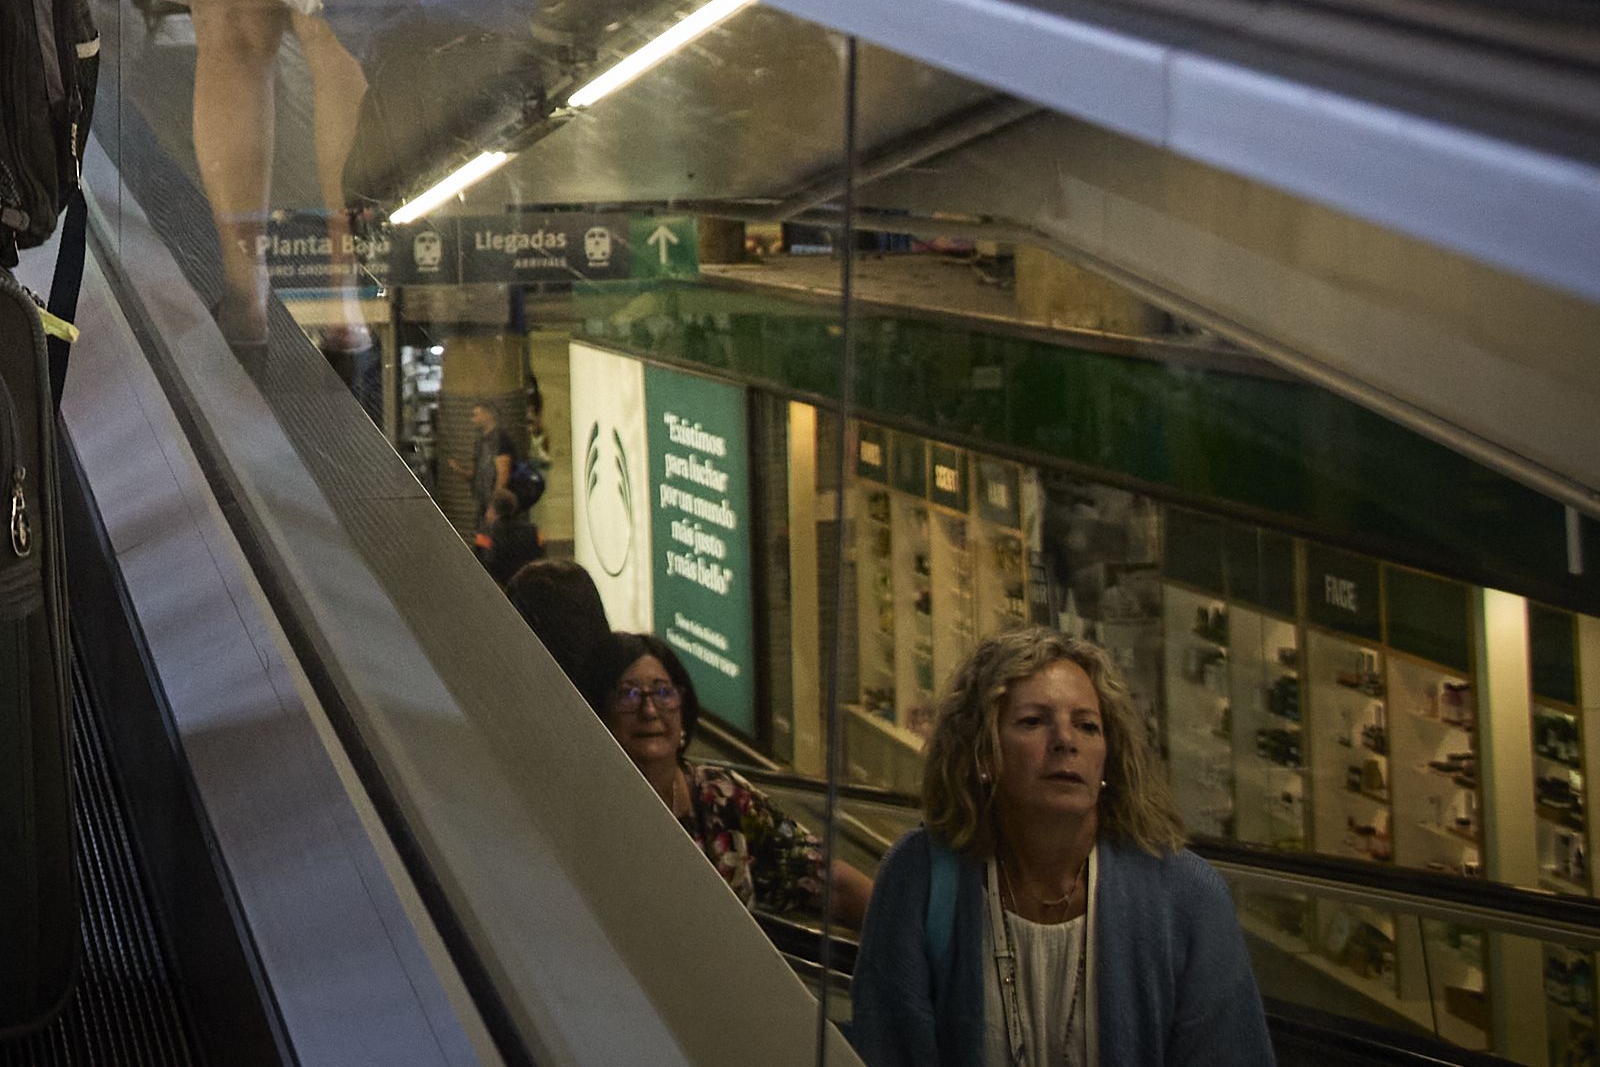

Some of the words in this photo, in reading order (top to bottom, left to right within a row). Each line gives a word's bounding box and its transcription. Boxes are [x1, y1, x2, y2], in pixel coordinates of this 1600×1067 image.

[256, 234, 332, 255] Planta
[475, 229, 567, 254] Llegadas
[694, 497, 737, 529] mundo
[694, 523, 726, 559] justo
[1324, 575, 1357, 614] FACE
